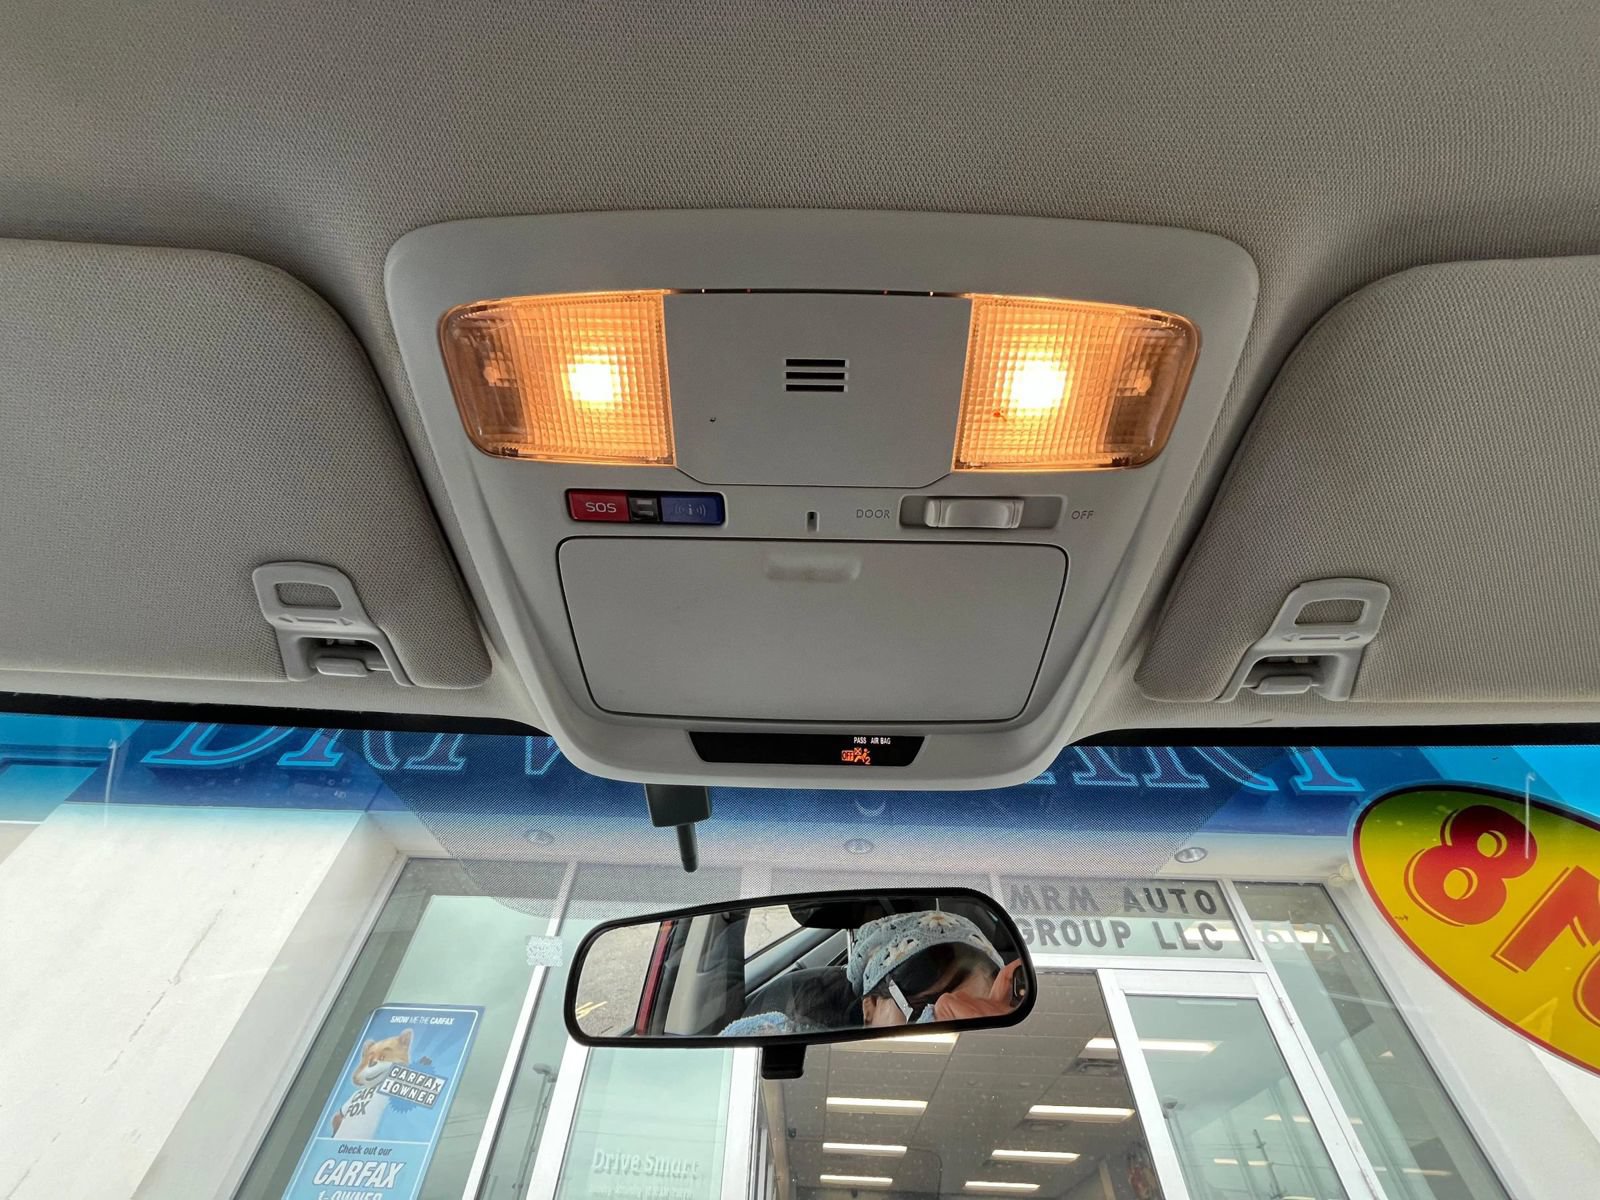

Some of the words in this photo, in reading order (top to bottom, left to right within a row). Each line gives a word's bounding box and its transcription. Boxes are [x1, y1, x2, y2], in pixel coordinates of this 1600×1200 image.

[585, 501, 617, 514] SOS
[856, 508, 890, 520] DOOR
[1071, 509, 1094, 520] OFF
[853, 736, 867, 744] PASS
[1009, 884, 1100, 913] MRM
[1123, 887, 1218, 915] AUTO
[1018, 918, 1132, 948] GROUP
[1152, 921, 1224, 951] LLC
[390, 1015, 409, 1024] SHOW
[418, 1016, 430, 1024] THE
[429, 1016, 455, 1025] CARFAX
[391, 1067, 442, 1093] CARFAX
[351, 1087, 377, 1103] CAR
[346, 1101, 370, 1118] FOX
[338, 1144, 362, 1155] Check
[363, 1145, 378, 1156] out
[378, 1147, 392, 1157] our
[591, 1149, 641, 1175] Drive
[644, 1153, 700, 1180] Smart
[313, 1158, 406, 1189] CARFAX
